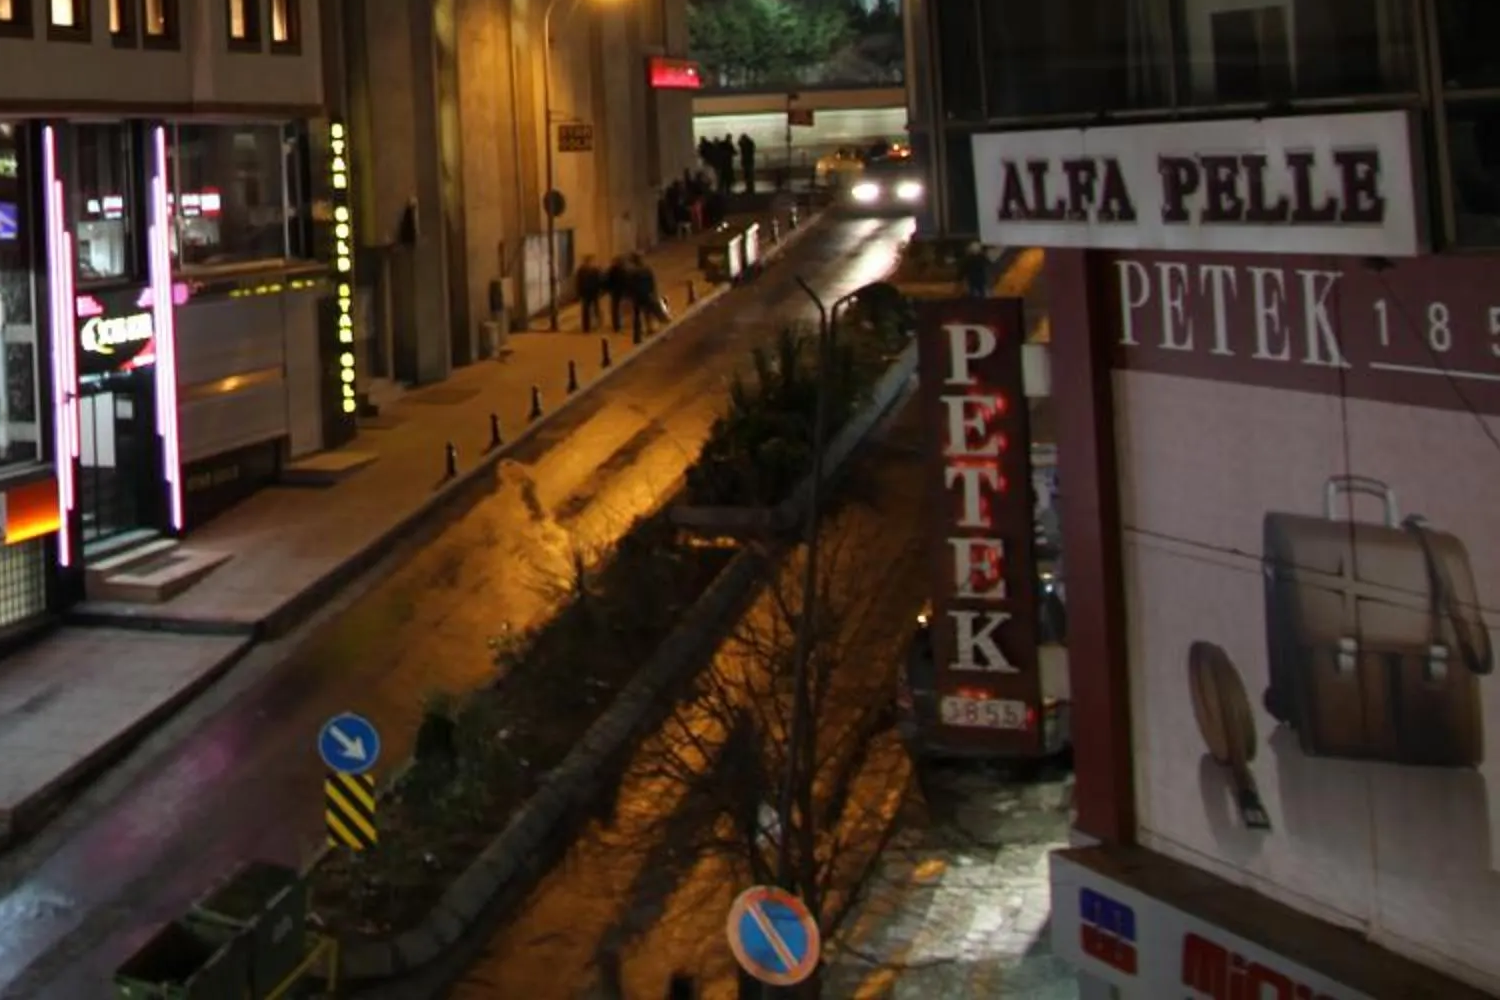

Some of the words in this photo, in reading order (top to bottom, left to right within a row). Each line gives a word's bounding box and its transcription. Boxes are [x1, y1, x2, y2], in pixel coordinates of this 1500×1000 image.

[330, 123, 348, 188] STAR
[997, 156, 1137, 222] ALFA
[1157, 151, 1386, 223] PELLE
[333, 206, 351, 272] GOLD
[1115, 259, 1353, 368] PETEK
[939, 323, 1020, 673] PETEK
